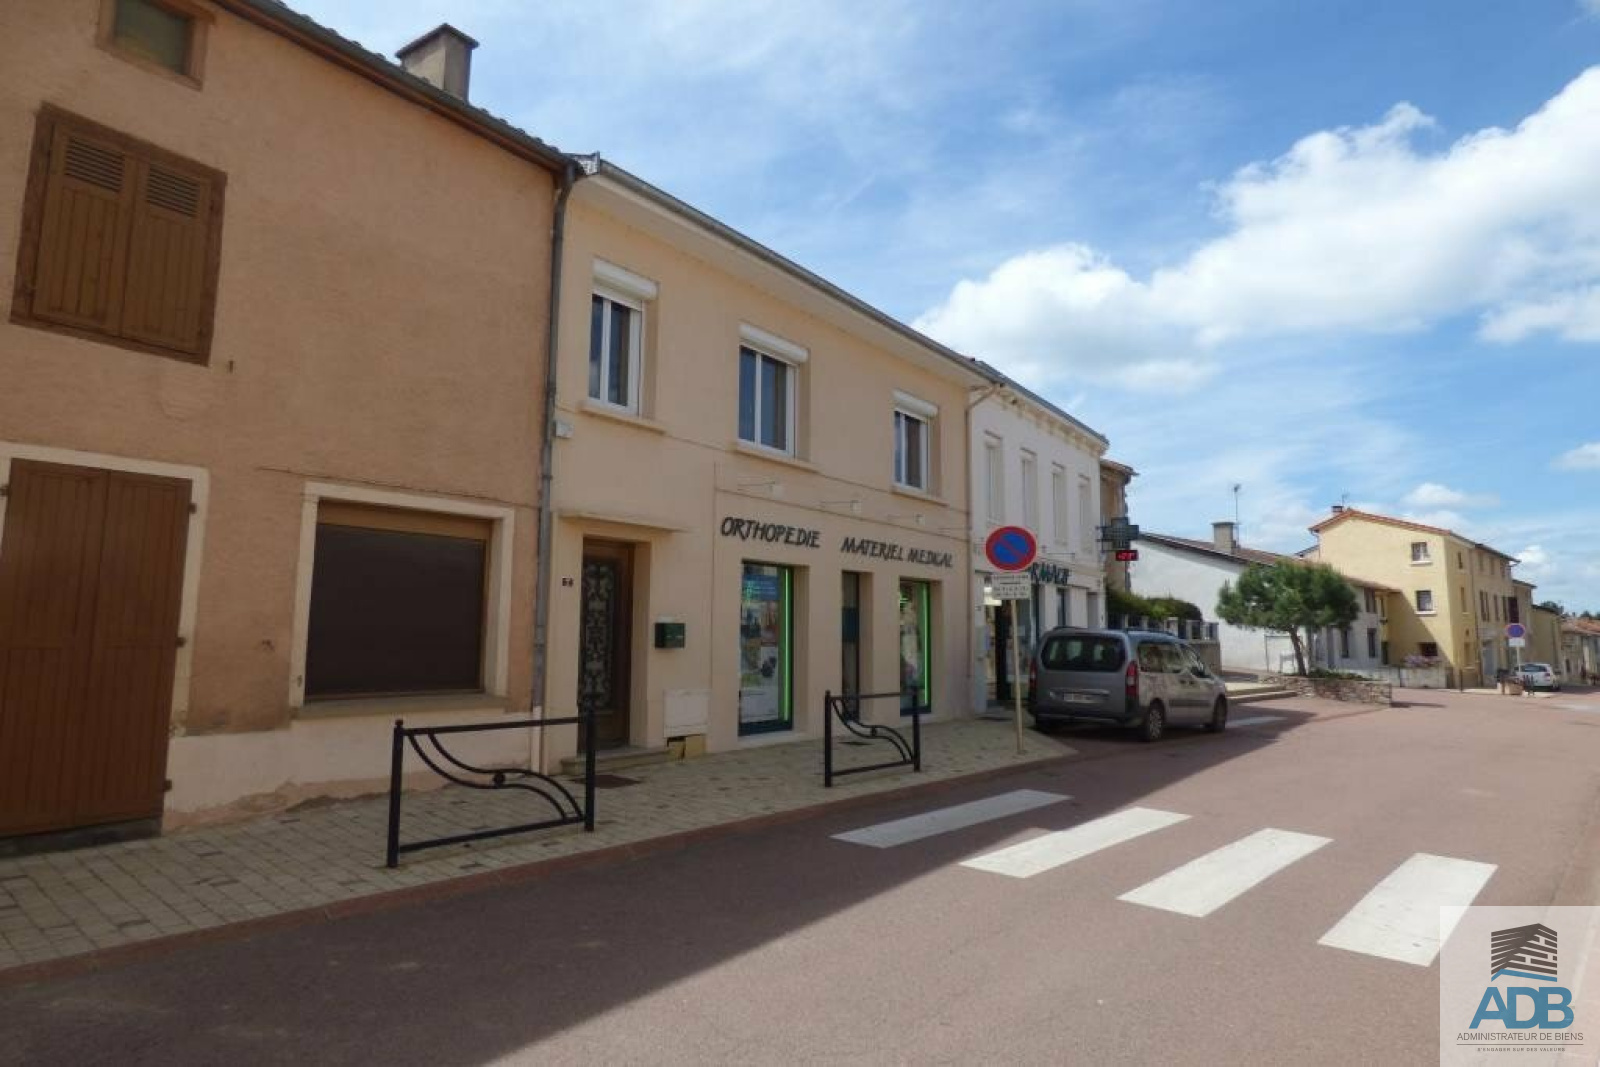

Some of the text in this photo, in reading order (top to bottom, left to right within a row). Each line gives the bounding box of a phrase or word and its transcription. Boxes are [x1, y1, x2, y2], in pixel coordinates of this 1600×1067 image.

[720, 516, 821, 549] ORTHOPEDIE
[841, 536, 954, 568] MATERIEL MEDICAL
